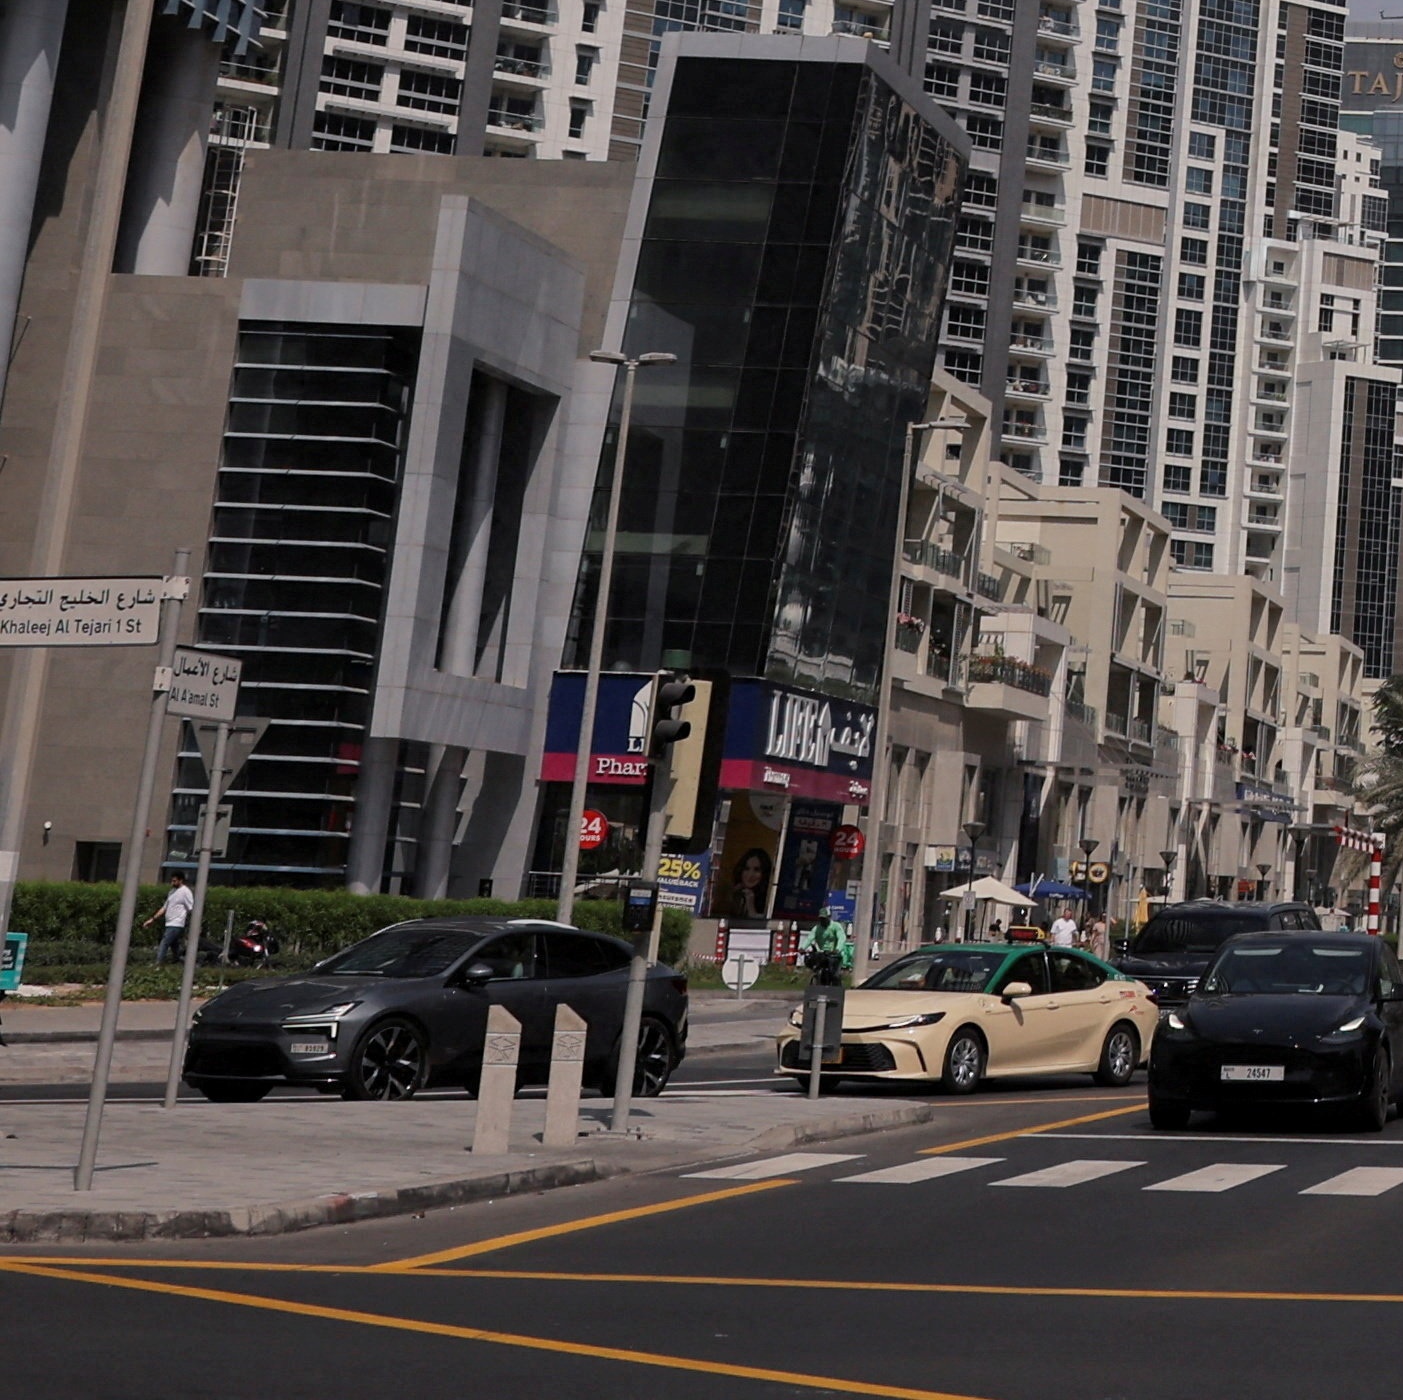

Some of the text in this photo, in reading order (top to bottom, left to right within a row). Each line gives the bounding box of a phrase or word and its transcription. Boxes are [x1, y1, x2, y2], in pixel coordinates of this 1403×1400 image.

[59, 589, 110, 611] الخليج
[117, 589, 156, 611] شارع
[0, 618, 142, 636] Khaleej Al Tejari 1 St
[174, 657, 238, 685] شارع الأعمال
[170, 687, 180, 701] Al
[209, 693, 220, 708] St
[765, 689, 819, 762] LIFE
[596, 757, 648, 776] Phar
[580, 834, 601, 842] OURS
[834, 831, 859, 847] 24
[657, 858, 702, 880] 25%
[1246, 1067, 1271, 1079] 24547
